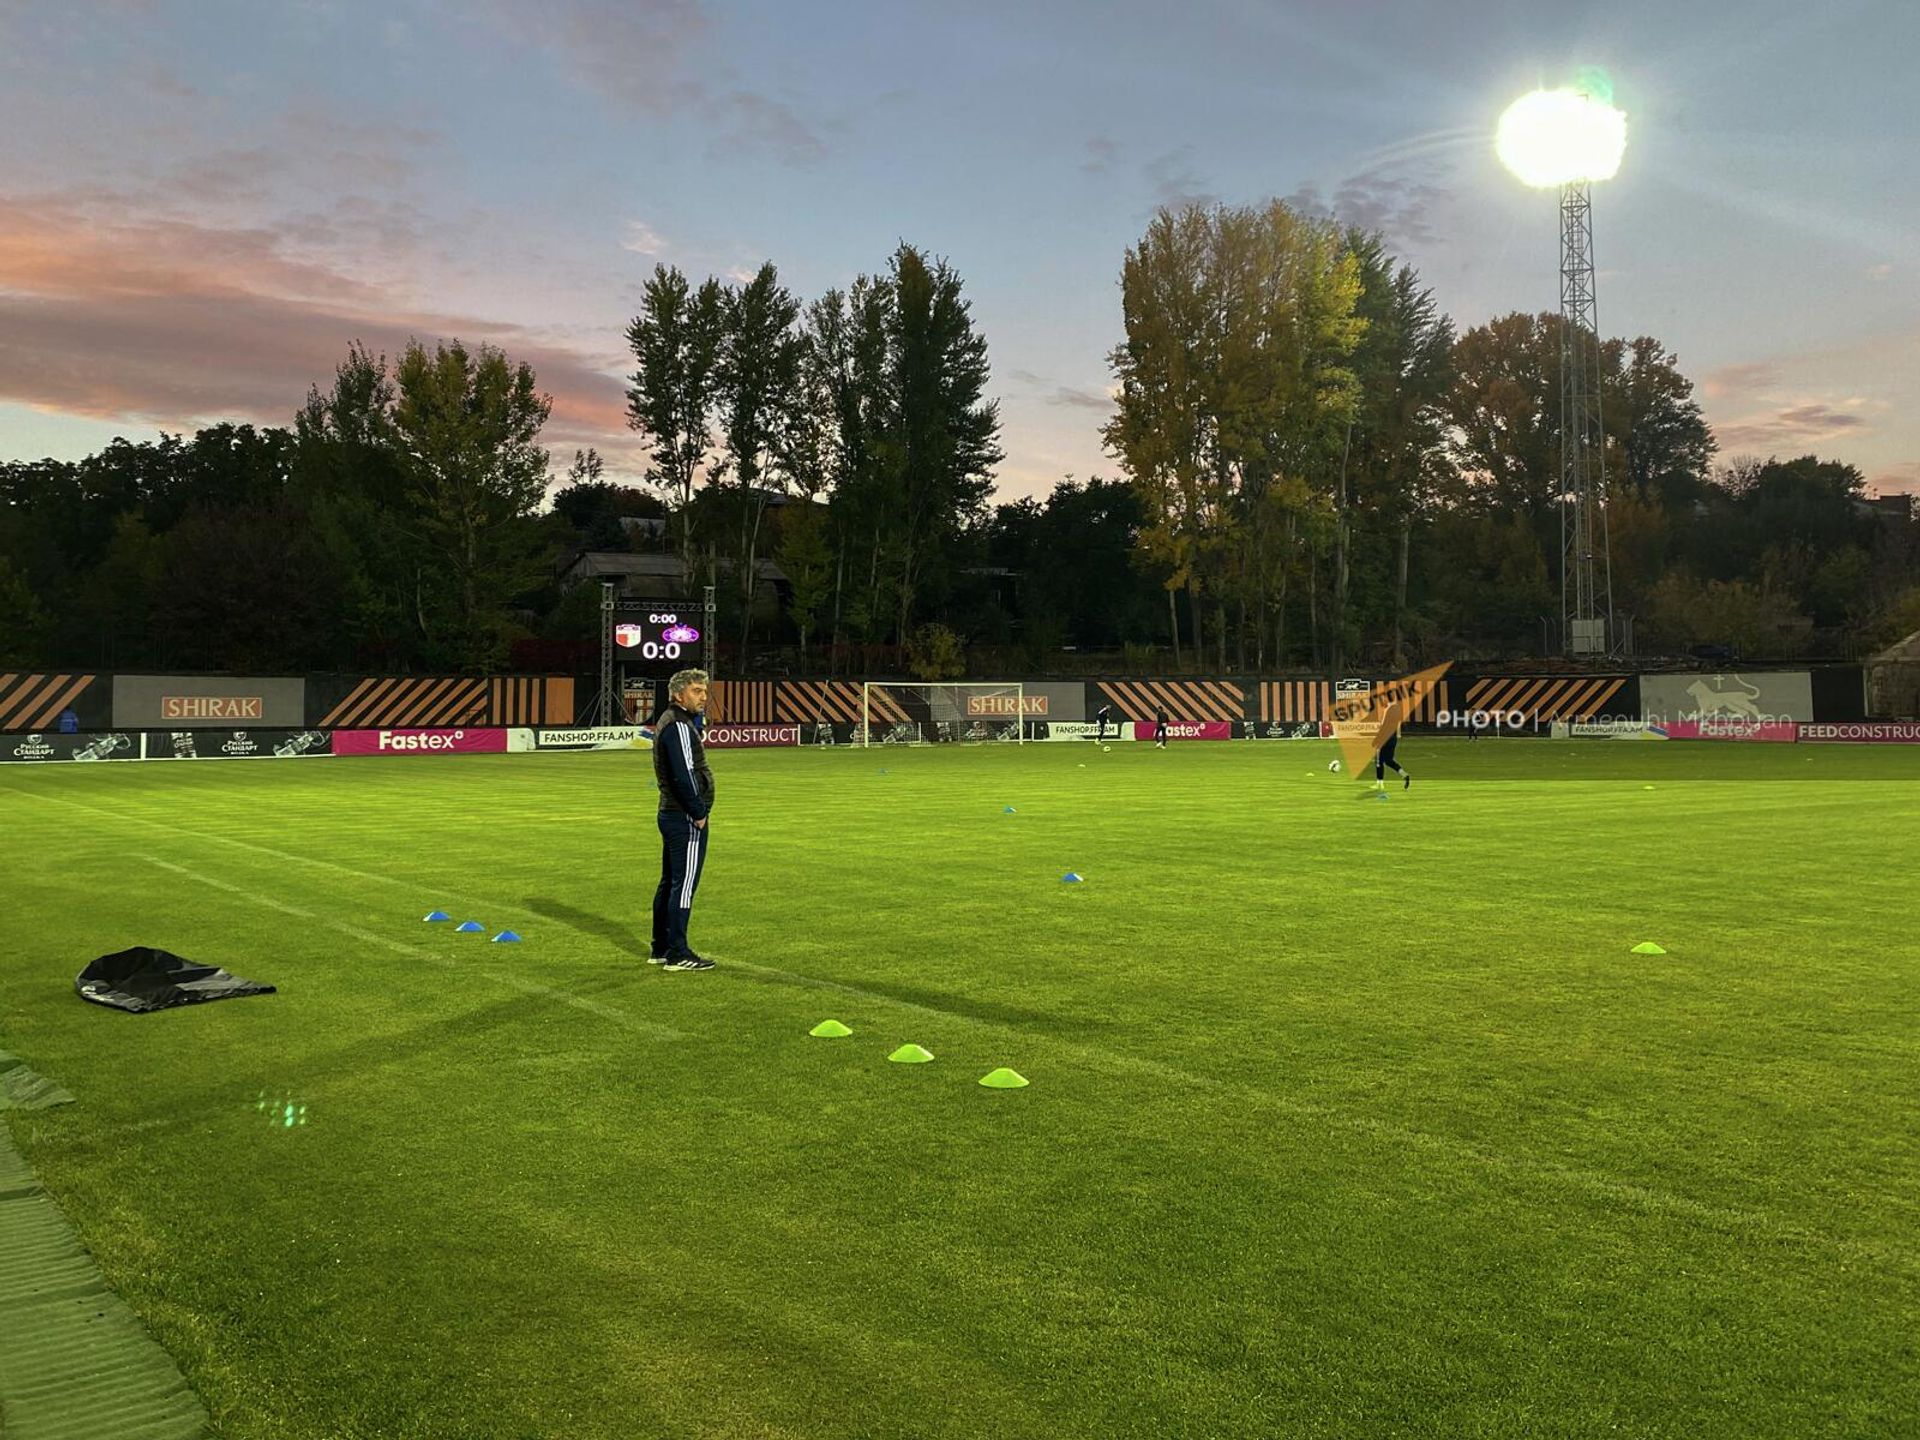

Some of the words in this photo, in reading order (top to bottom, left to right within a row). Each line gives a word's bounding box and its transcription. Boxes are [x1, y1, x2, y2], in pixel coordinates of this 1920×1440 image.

[649, 614, 677, 624] 0:00
[642, 642, 681, 660] 0:0
[168, 699, 257, 717] SHIRAK
[970, 698, 1042, 713] SHIRAK
[544, 731, 633, 743] FANSHOP.FFA.AM
